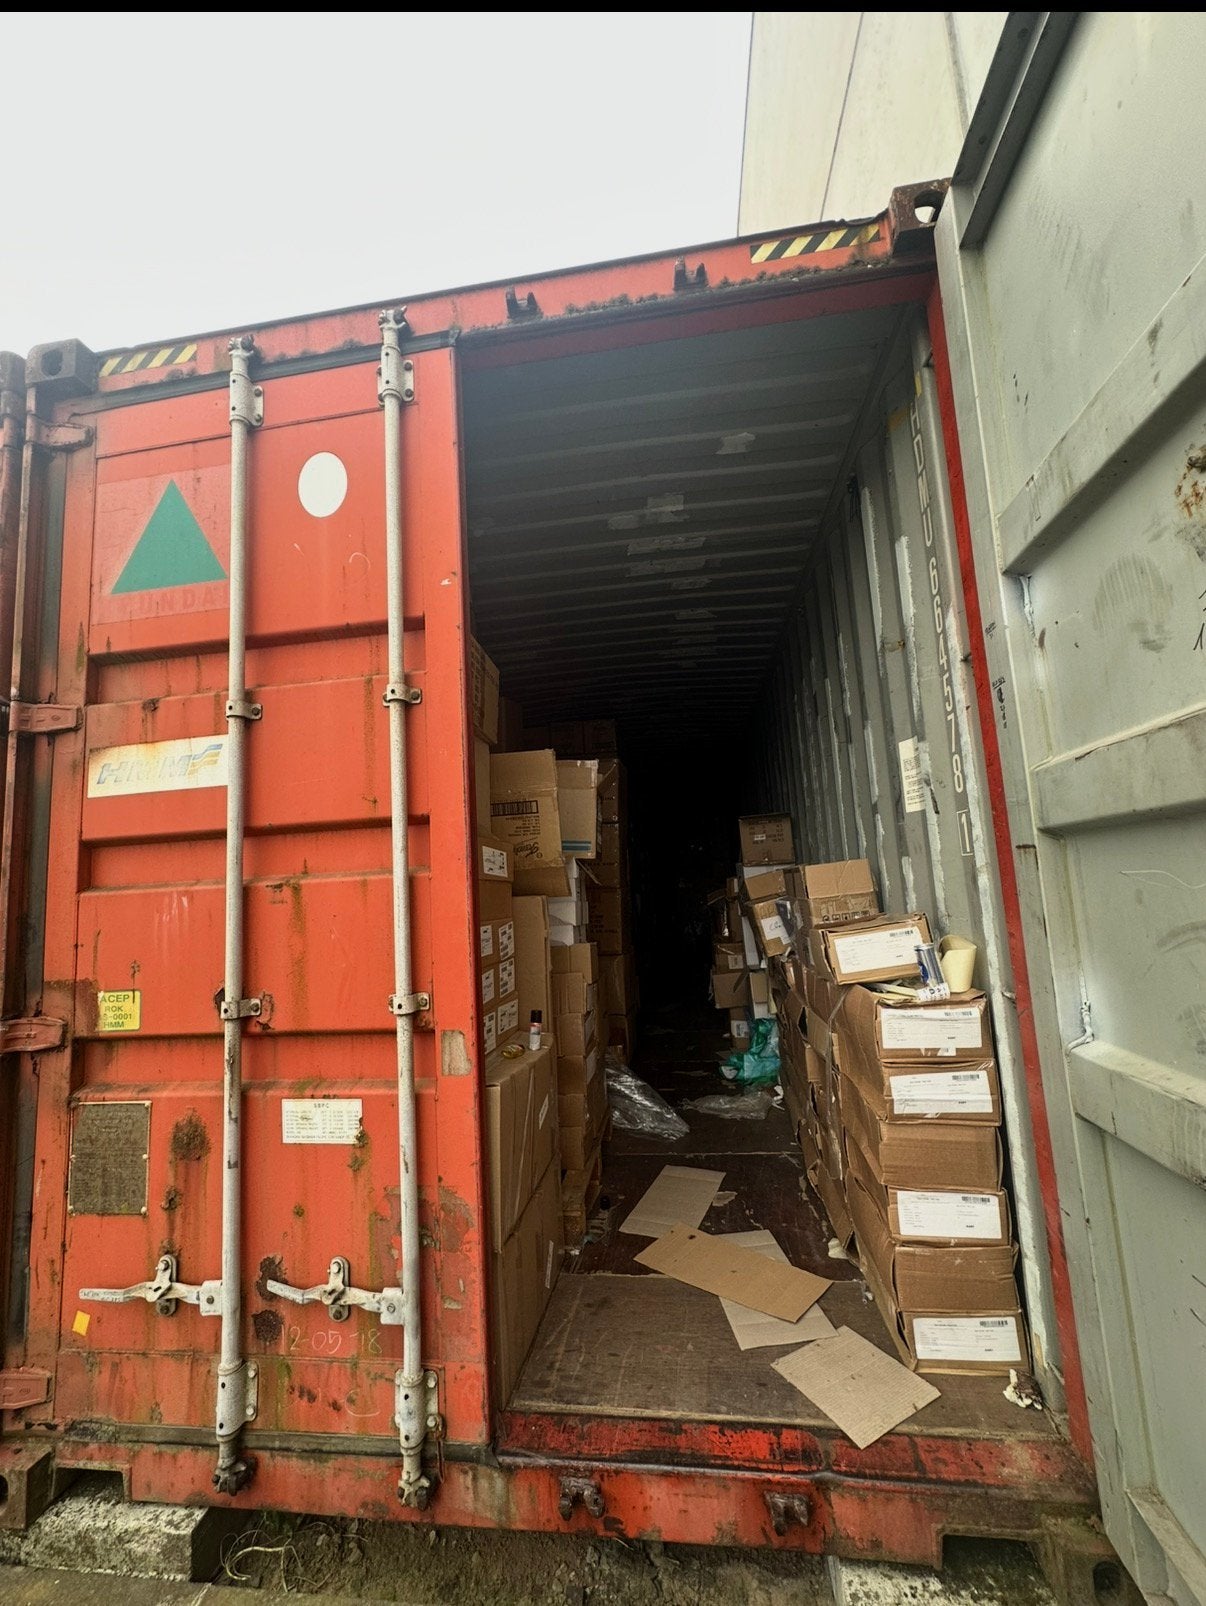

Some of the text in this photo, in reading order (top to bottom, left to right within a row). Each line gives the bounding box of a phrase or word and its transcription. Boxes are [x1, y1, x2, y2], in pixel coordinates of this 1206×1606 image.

[910, 399, 971, 854] HDMU 664578 1
[100, 994, 130, 1003] ACEP
[104, 1005, 124, 1013] ROK
